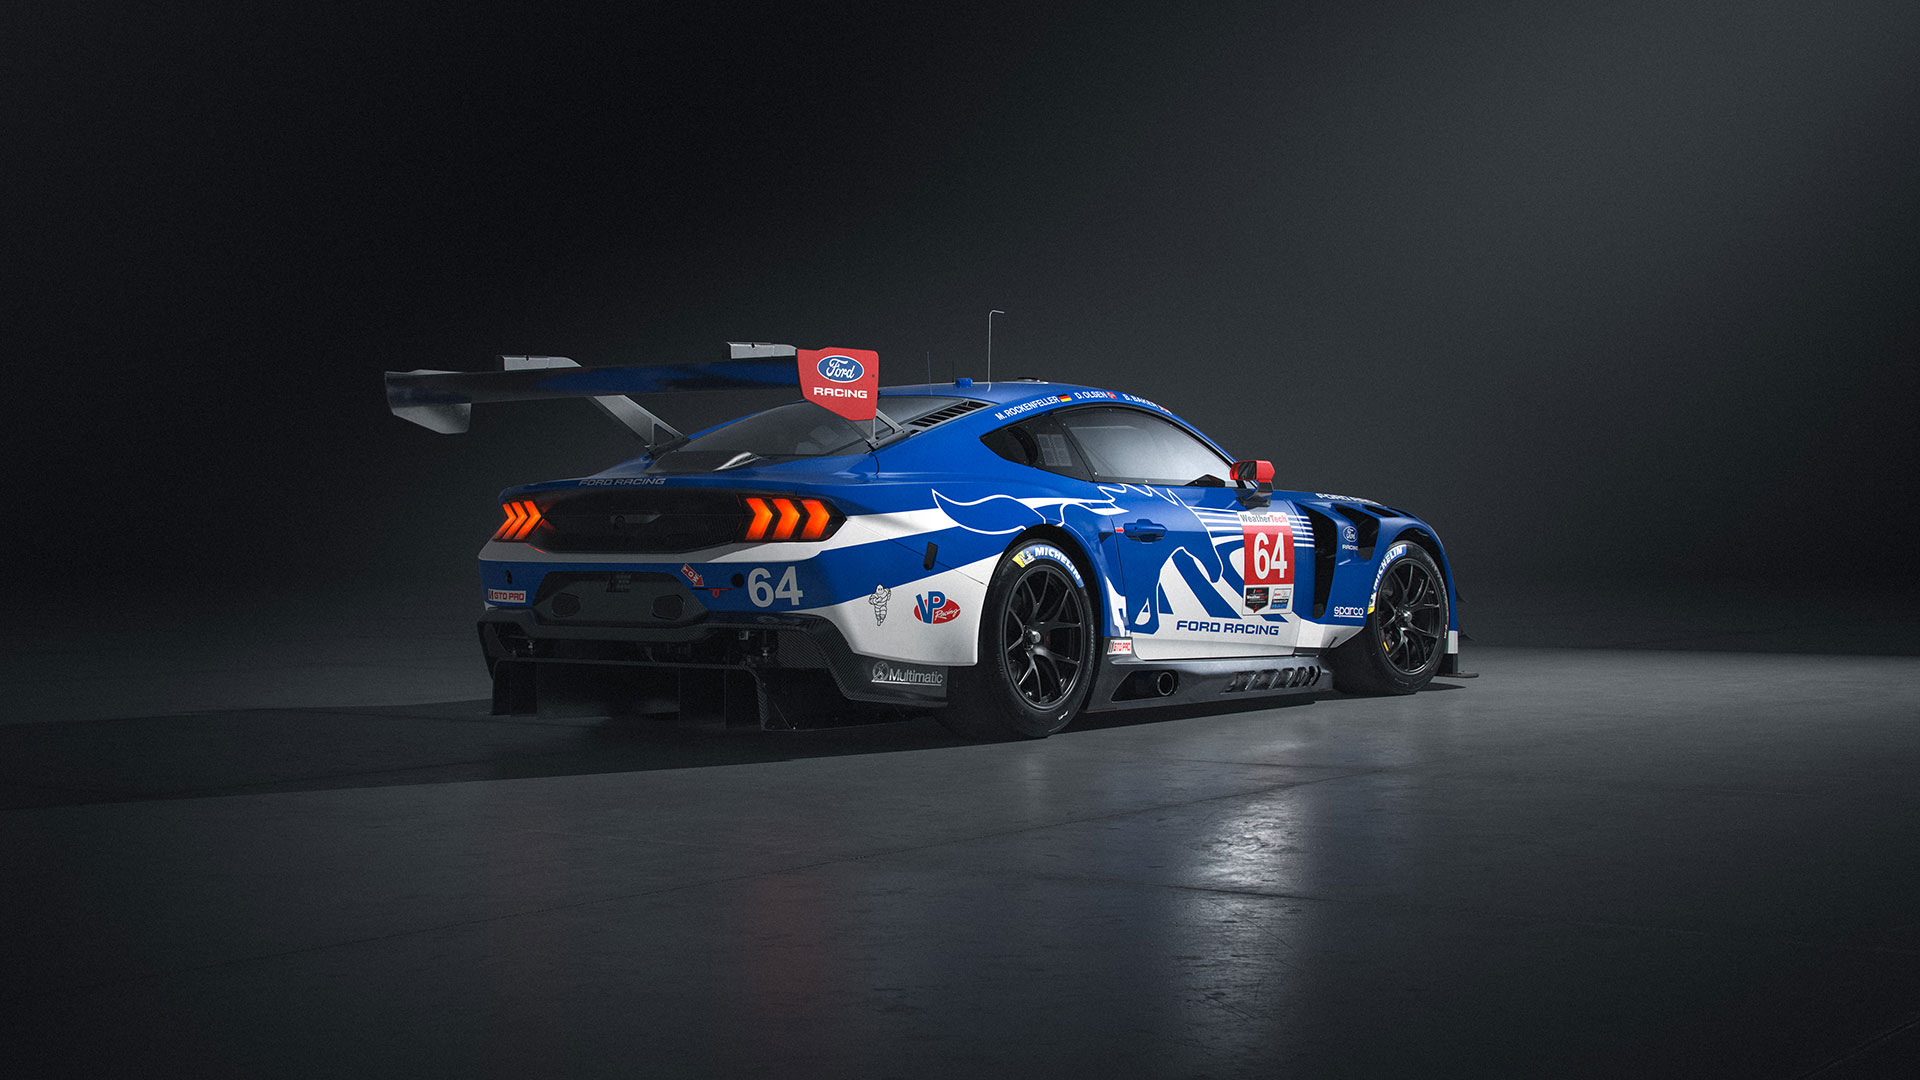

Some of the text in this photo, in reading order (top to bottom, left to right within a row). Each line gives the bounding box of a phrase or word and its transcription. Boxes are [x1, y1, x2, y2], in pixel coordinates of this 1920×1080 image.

[826, 358, 856, 379] Ford
[813, 387, 868, 399] RACING
[578, 478, 667, 487] FORD RACING
[1240, 514, 1289, 524] WeatherTech
[1034, 546, 1082, 581] MICHELIN
[1254, 532, 1288, 580] 64
[747, 566, 804, 608] 64
[508, 592, 525, 601] PRO
[915, 591, 947, 625] VP
[934, 607, 961, 621] Racing
[1333, 606, 1364, 618] sparco
[1176, 620, 1280, 636] FORD RACING
[889, 668, 943, 684] Multimatic
